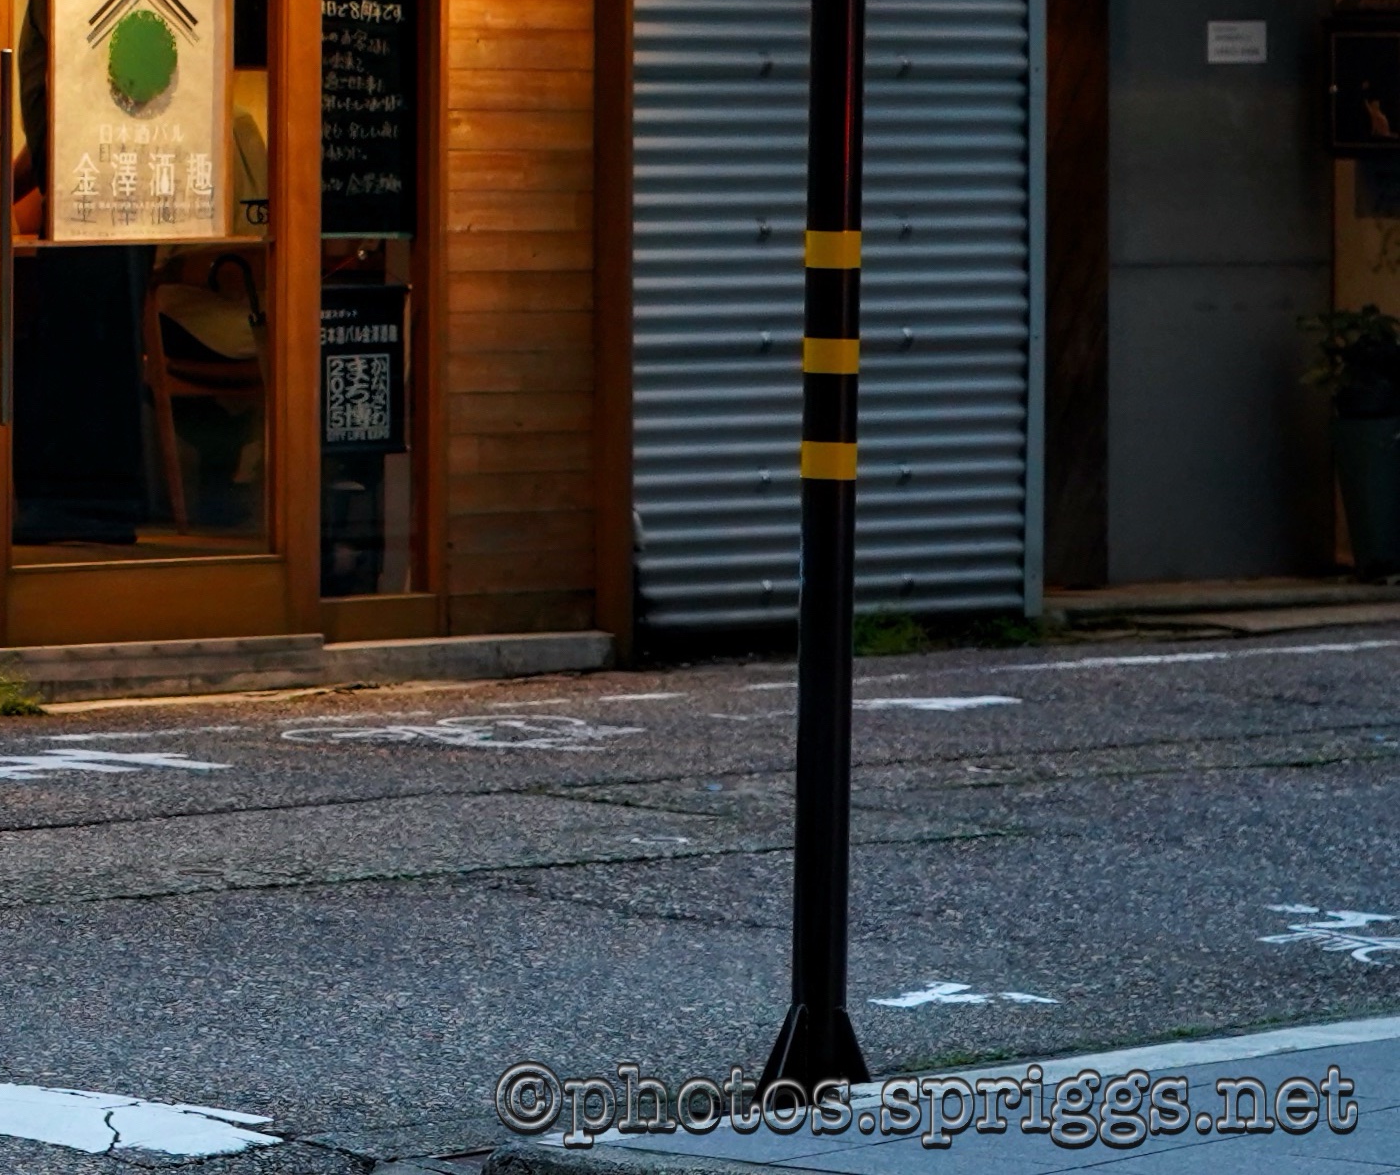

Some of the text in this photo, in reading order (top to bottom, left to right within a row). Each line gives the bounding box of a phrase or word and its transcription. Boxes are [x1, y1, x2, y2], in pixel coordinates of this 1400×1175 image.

[98, 123, 185, 144] 日本酒バル
[329, 358, 345, 428] 2025
